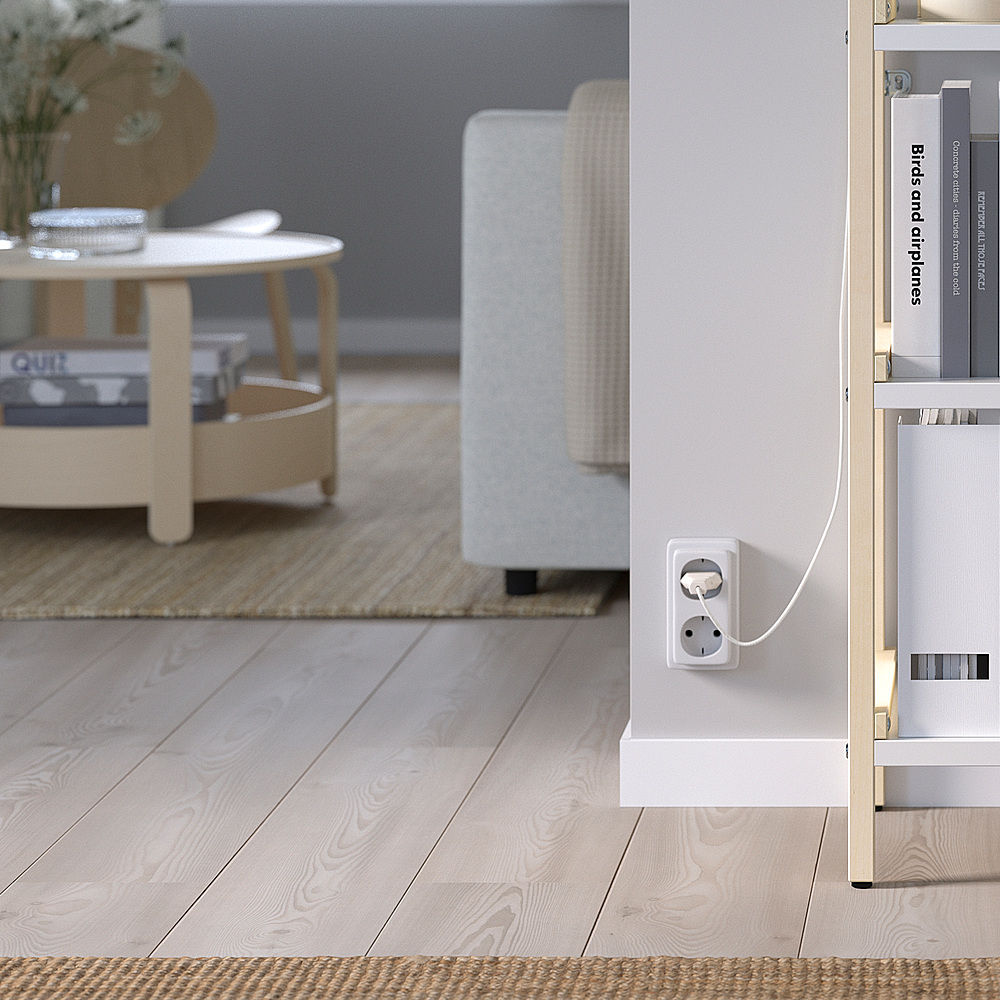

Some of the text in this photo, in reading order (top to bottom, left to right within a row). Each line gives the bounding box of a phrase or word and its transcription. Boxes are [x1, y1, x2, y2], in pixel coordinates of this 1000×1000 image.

[952, 140, 960, 179] Concrete
[952, 180, 960, 203] cities
[908, 144, 925, 306] Birds and airplanes
[952, 209, 960, 239] diaries
[952, 240, 960, 261] from
[952, 262, 960, 277] the
[952, 277, 960, 296] cold
[11, 352, 69, 375] QUIZ
